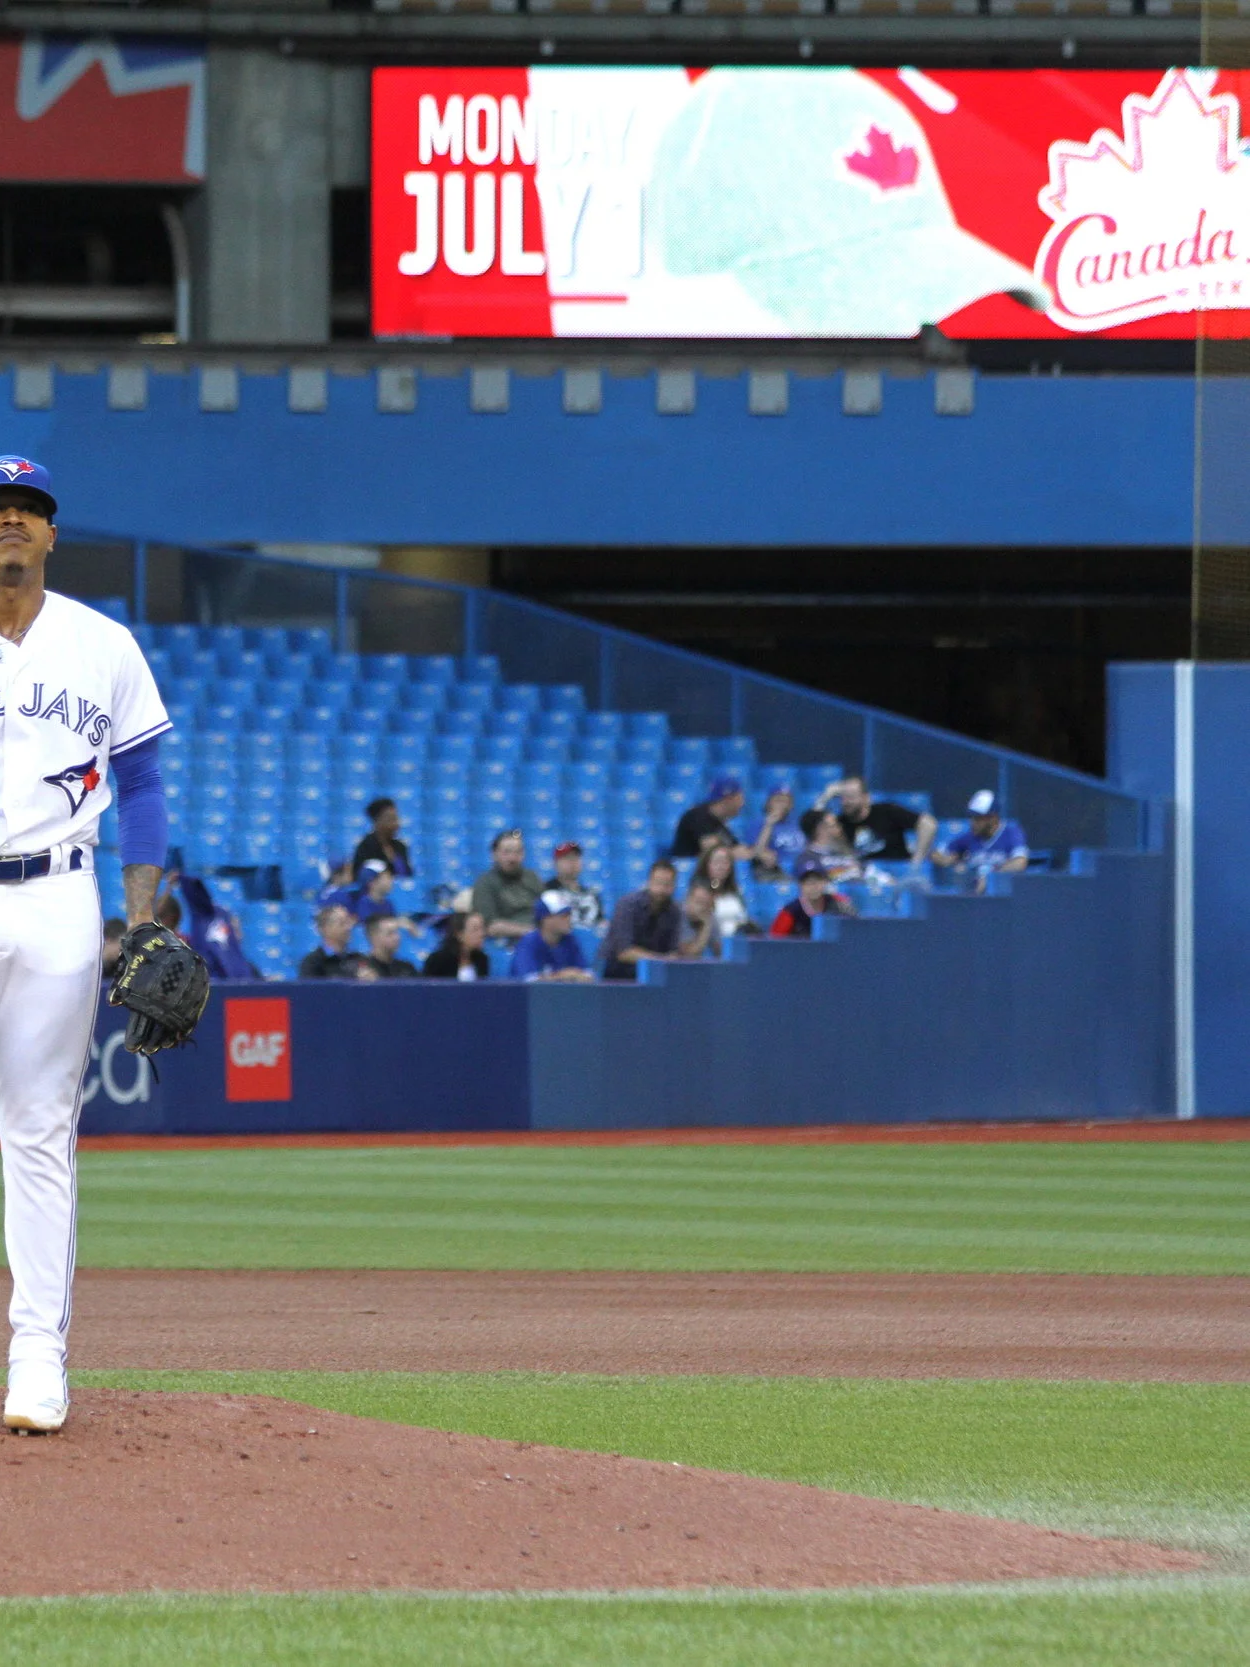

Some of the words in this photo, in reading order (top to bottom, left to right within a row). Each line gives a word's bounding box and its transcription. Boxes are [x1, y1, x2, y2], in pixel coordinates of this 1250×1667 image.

[1043, 207, 1238, 319] Canada
[18, 682, 112, 747] JAYS
[230, 1031, 287, 1068] GAF
